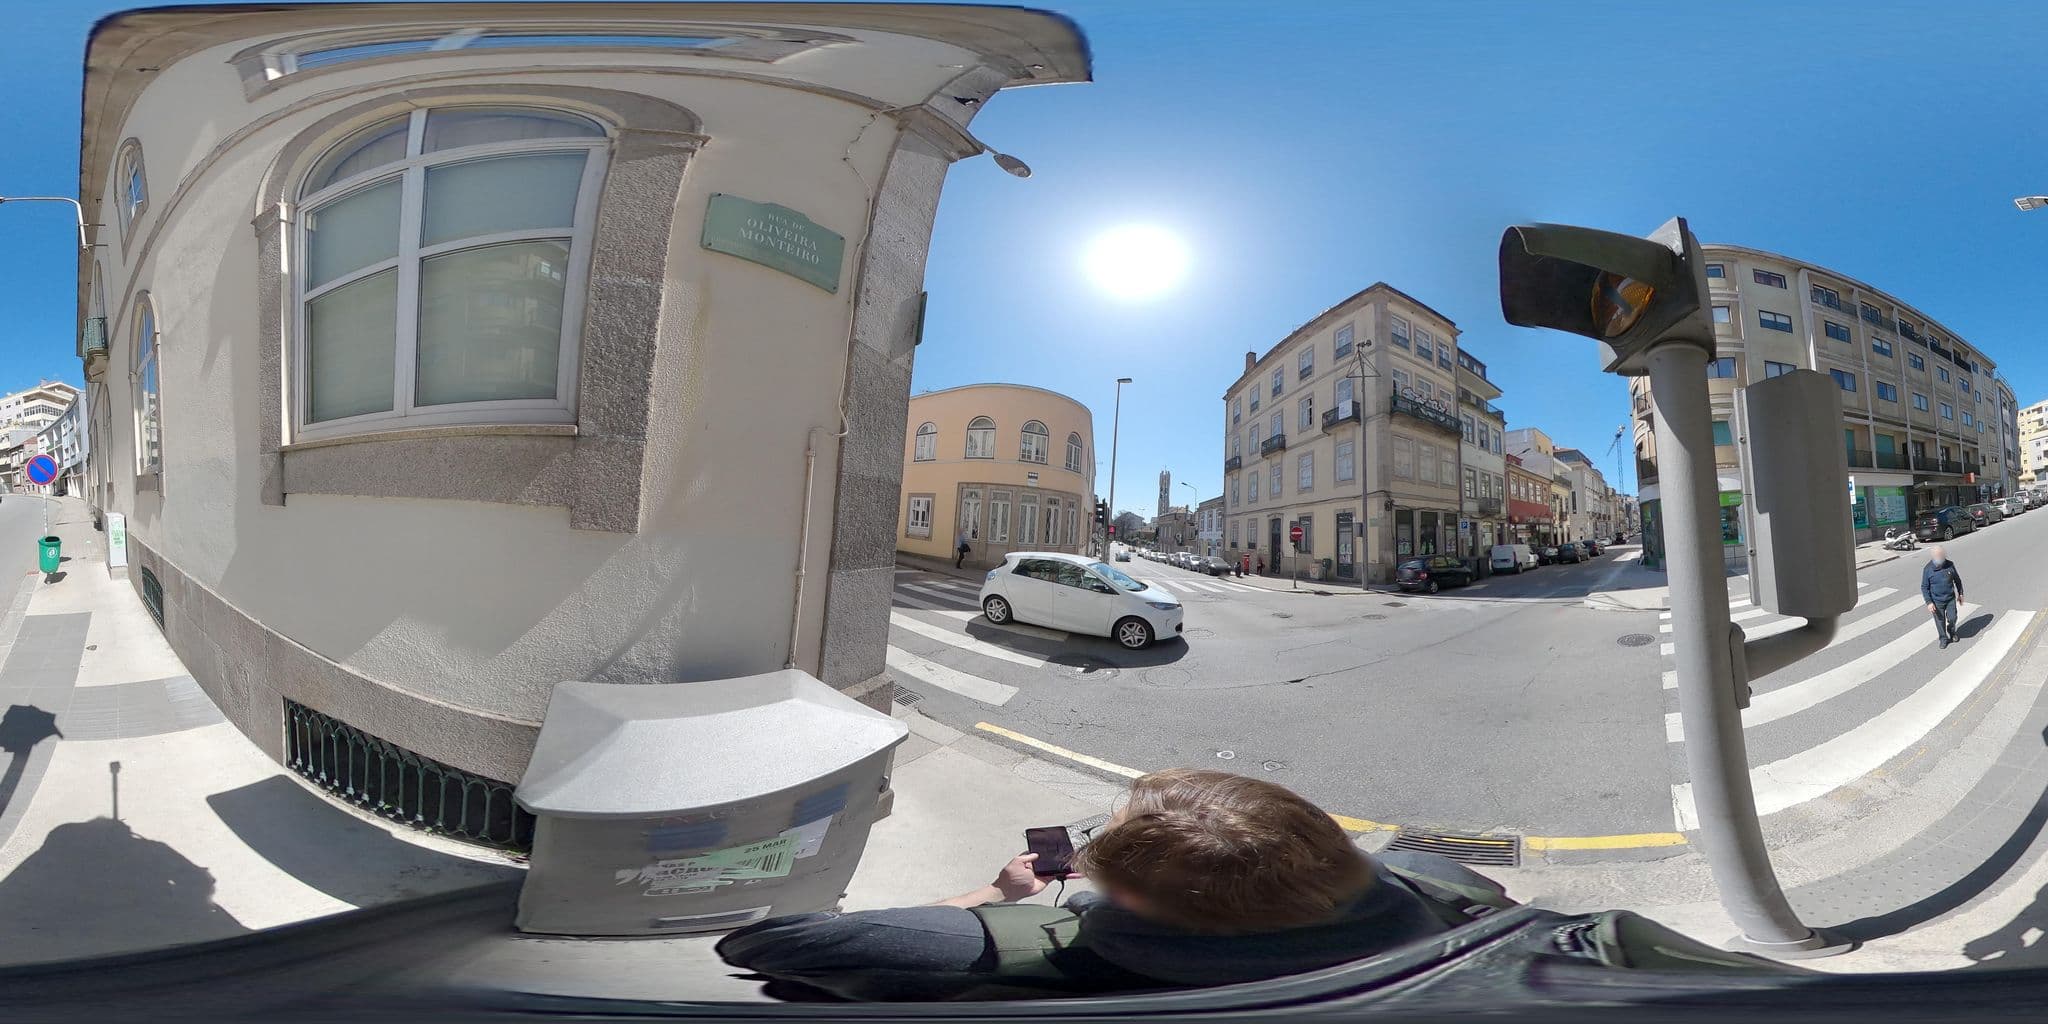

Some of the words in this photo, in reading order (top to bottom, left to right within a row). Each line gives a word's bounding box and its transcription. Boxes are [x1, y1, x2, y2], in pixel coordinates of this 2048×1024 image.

[747, 217, 817, 251] OLIVEIRA
[768, 213, 788, 225] RUA
[792, 221, 806, 231] DE
[739, 227, 820, 265] MONTEIRO
